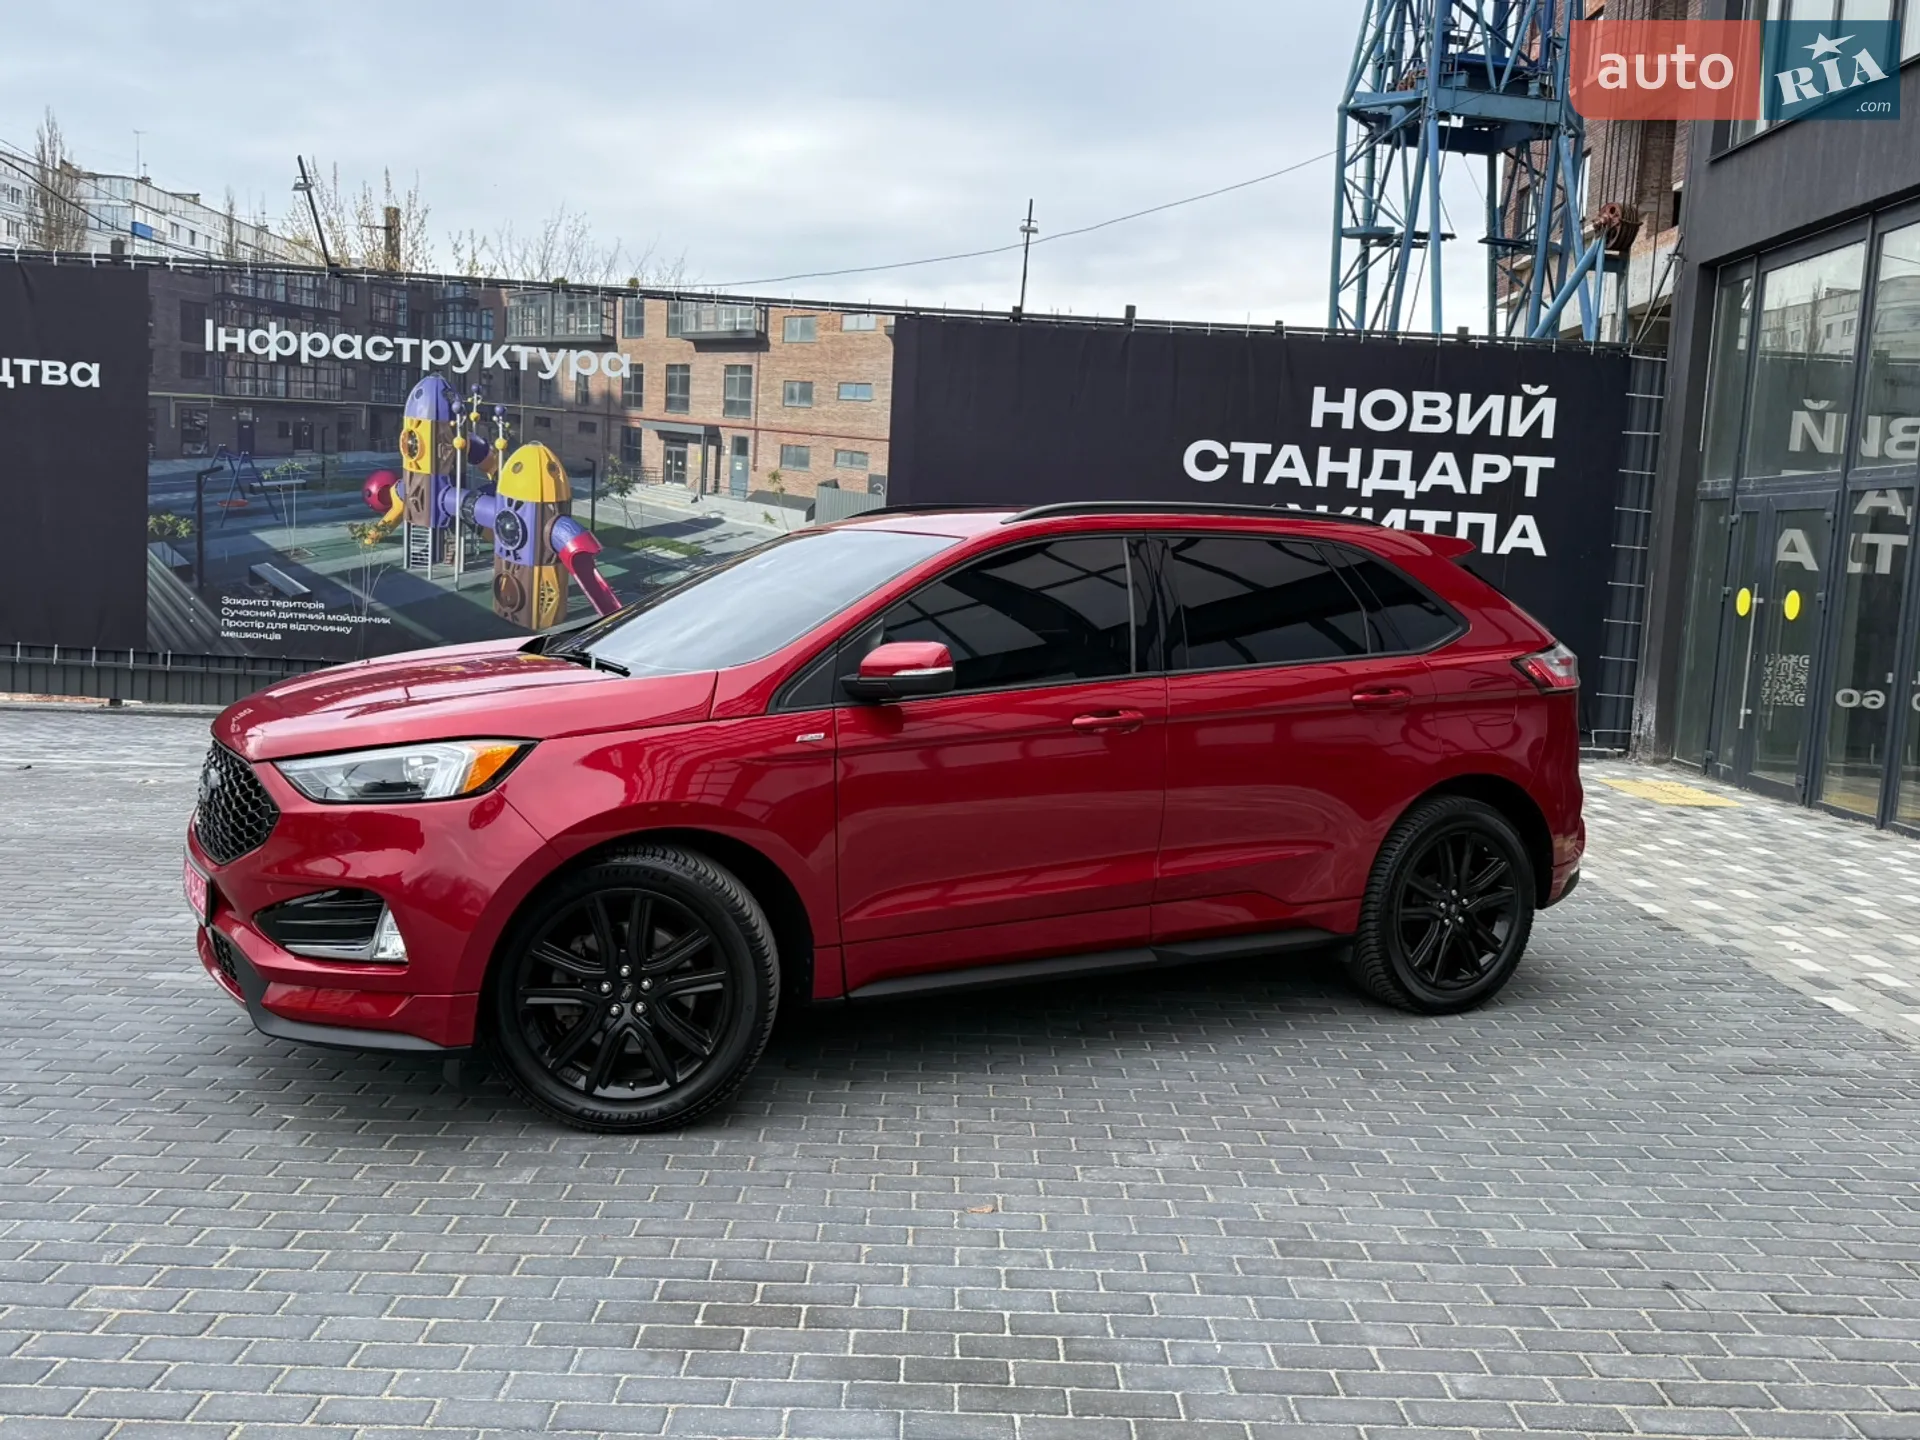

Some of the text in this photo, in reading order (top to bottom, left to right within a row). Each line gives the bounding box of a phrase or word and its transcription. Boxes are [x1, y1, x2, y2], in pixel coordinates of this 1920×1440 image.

[205, 319, 631, 380] Інфраструктура
[1310, 384, 1557, 439] НОВИЙ
[1182, 439, 1556, 499] СТАНДАРТ
[221, 596, 325, 610] Закрита територія
[221, 607, 391, 624] Сучасний дитячий майданчик
[221, 618, 353, 635] Простір для відпочинку
[221, 631, 282, 641] мешканців
